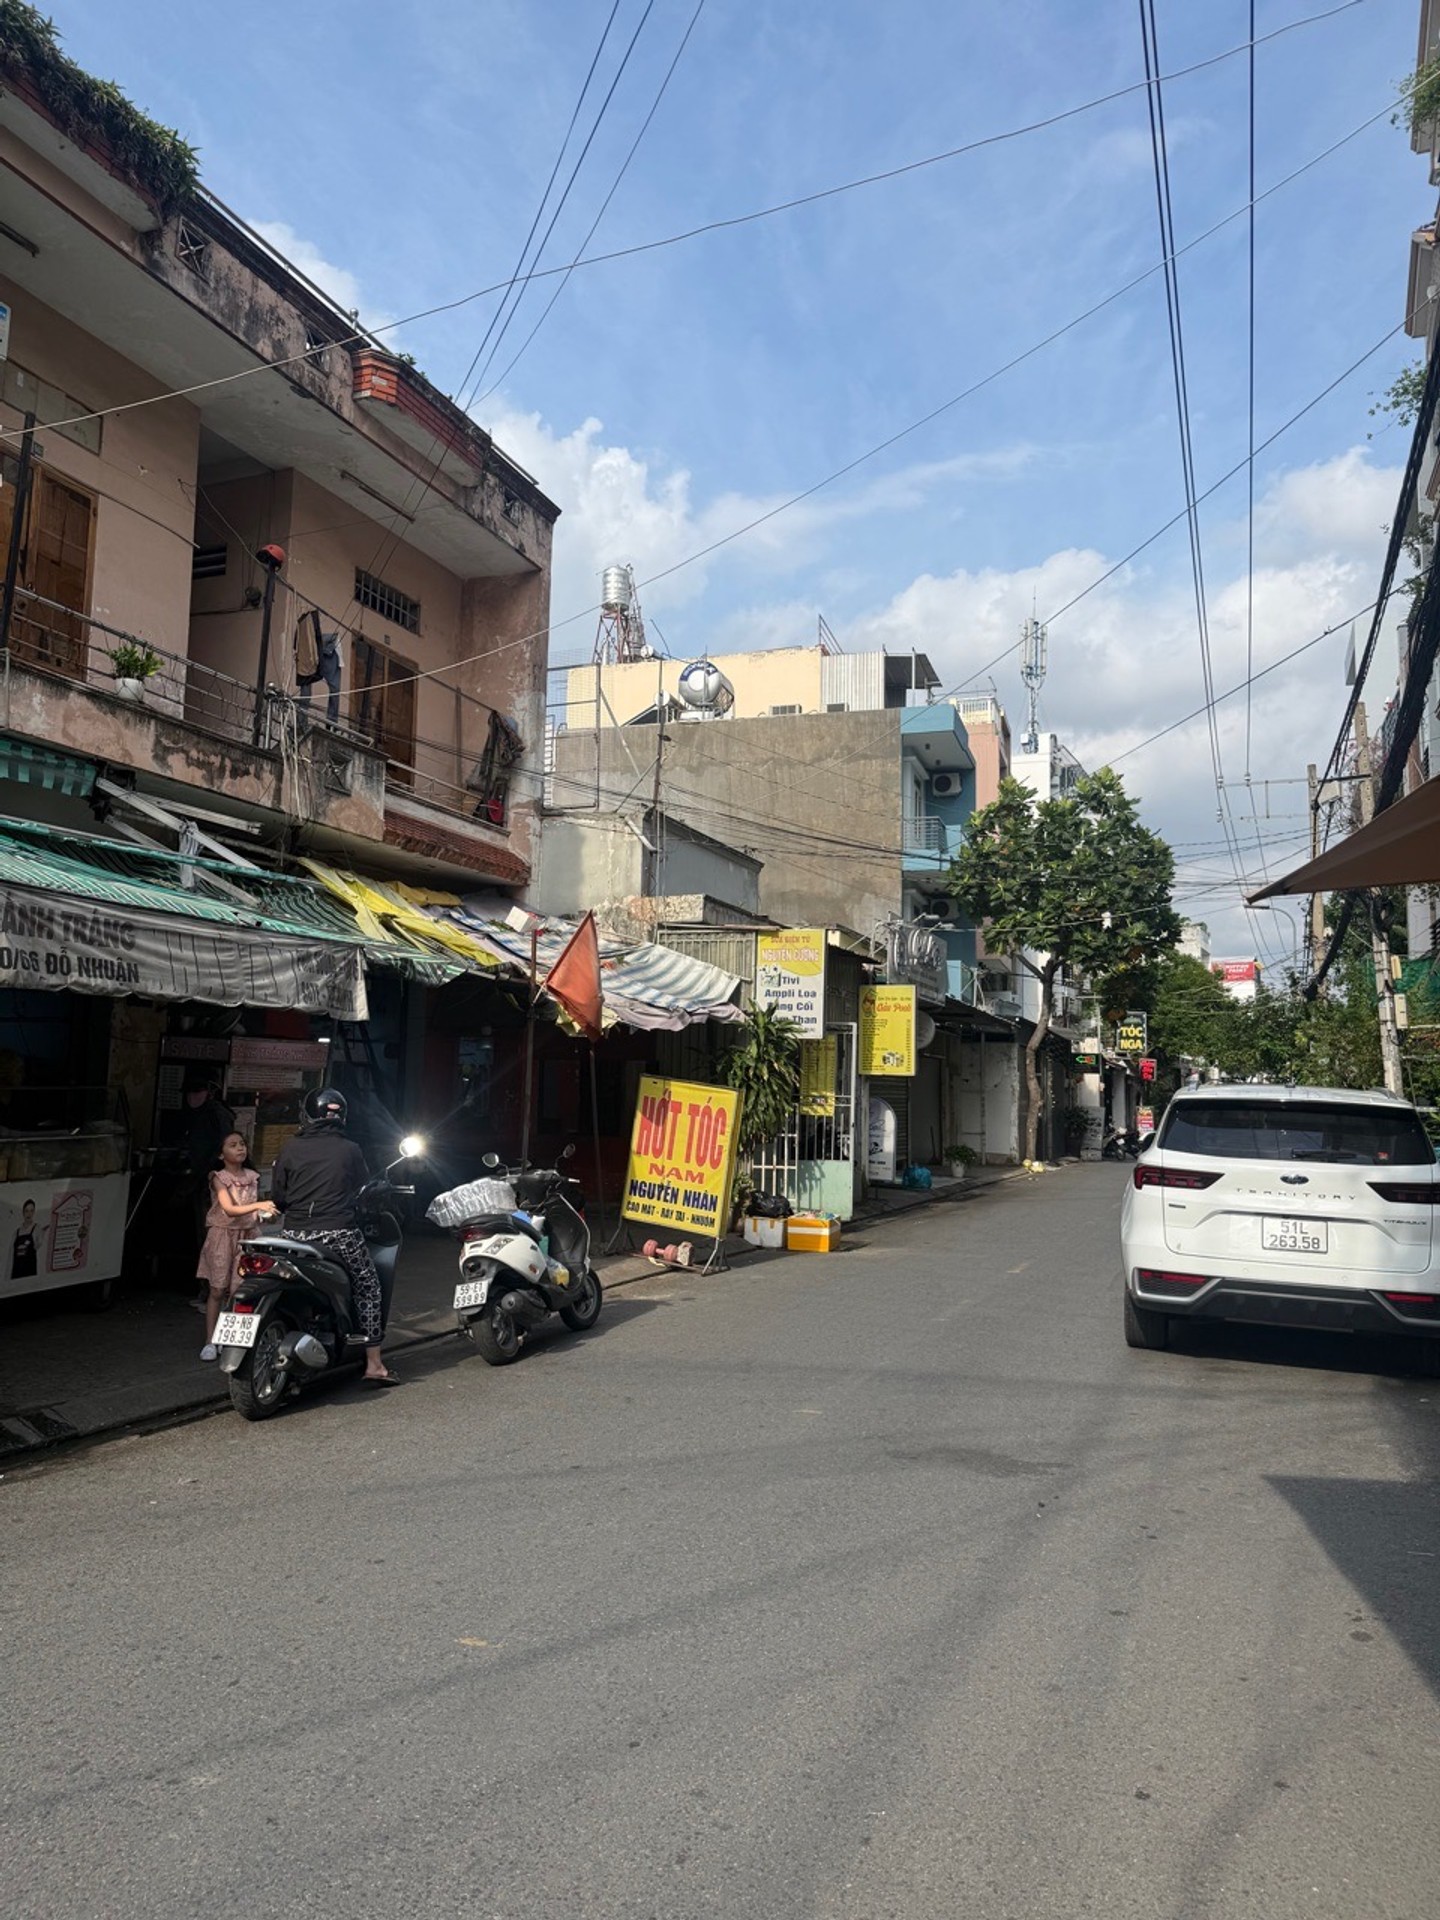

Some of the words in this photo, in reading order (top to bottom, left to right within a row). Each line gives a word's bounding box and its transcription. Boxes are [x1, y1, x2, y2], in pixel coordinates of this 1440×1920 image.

[61, 907, 136, 951] TRÁNG
[45, 946, 72, 976] ĐỖ
[77, 956, 140, 986] NHUẬN
[781, 976, 800, 985] Tivi
[764, 989, 795, 998] Ampli
[1120, 1024, 1143, 1037] TÓC
[1120, 1039, 1143, 1049] NGA
[636, 1088, 682, 1160] HỚT
[685, 1096, 727, 1170] TÓC
[648, 1162, 705, 1184] NAM
[1235, 1188, 1355, 1200] TERRITORY
[1280, 1221, 1309, 1235] 51L
[1269, 1234, 1320, 1250] 263.58
[217, 1329, 254, 1344] 198.39
